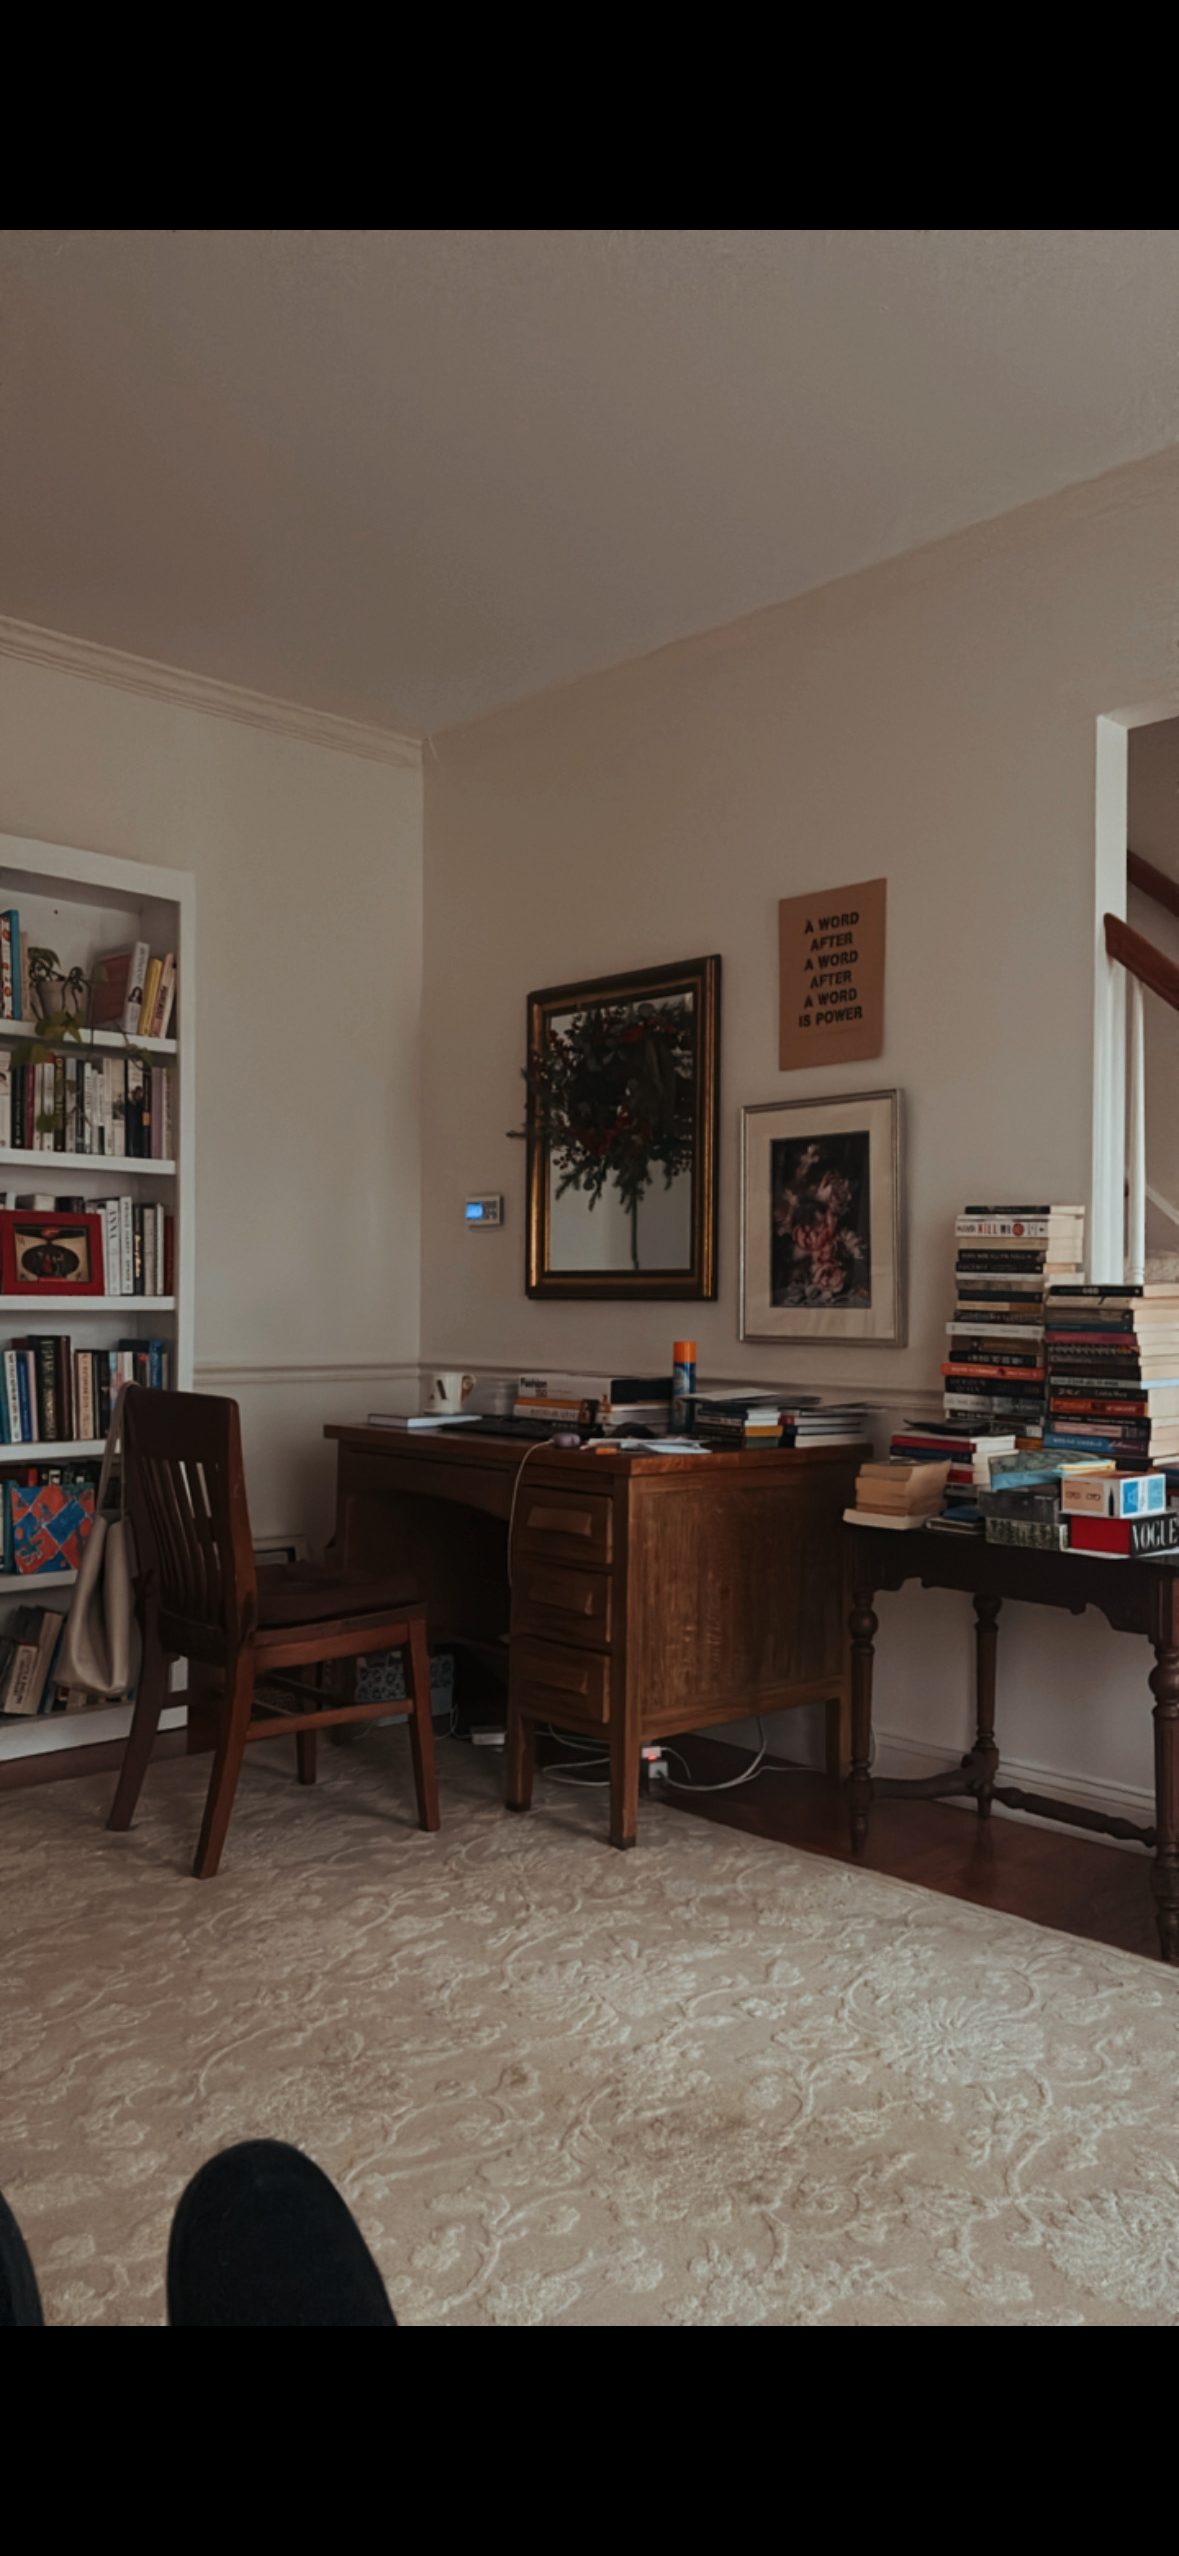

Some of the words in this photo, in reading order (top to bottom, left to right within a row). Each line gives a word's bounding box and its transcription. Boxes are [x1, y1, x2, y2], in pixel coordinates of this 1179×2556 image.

[804, 919, 814, 934] A
[818, 912, 859, 931] WORD
[810, 932, 853, 951] AFTER
[804, 958, 814, 971] A
[818, 950, 859, 970] WORD
[810, 970, 852, 989] AFTER
[804, 995, 813, 1009] A
[817, 988, 857, 1006] WORD
[799, 1014, 811, 1028] IS
[816, 1006, 863, 1026] POWER
[520, 1377, 548, 1388] Fashion
[1132, 1518, 1178, 1550] VOGUE
